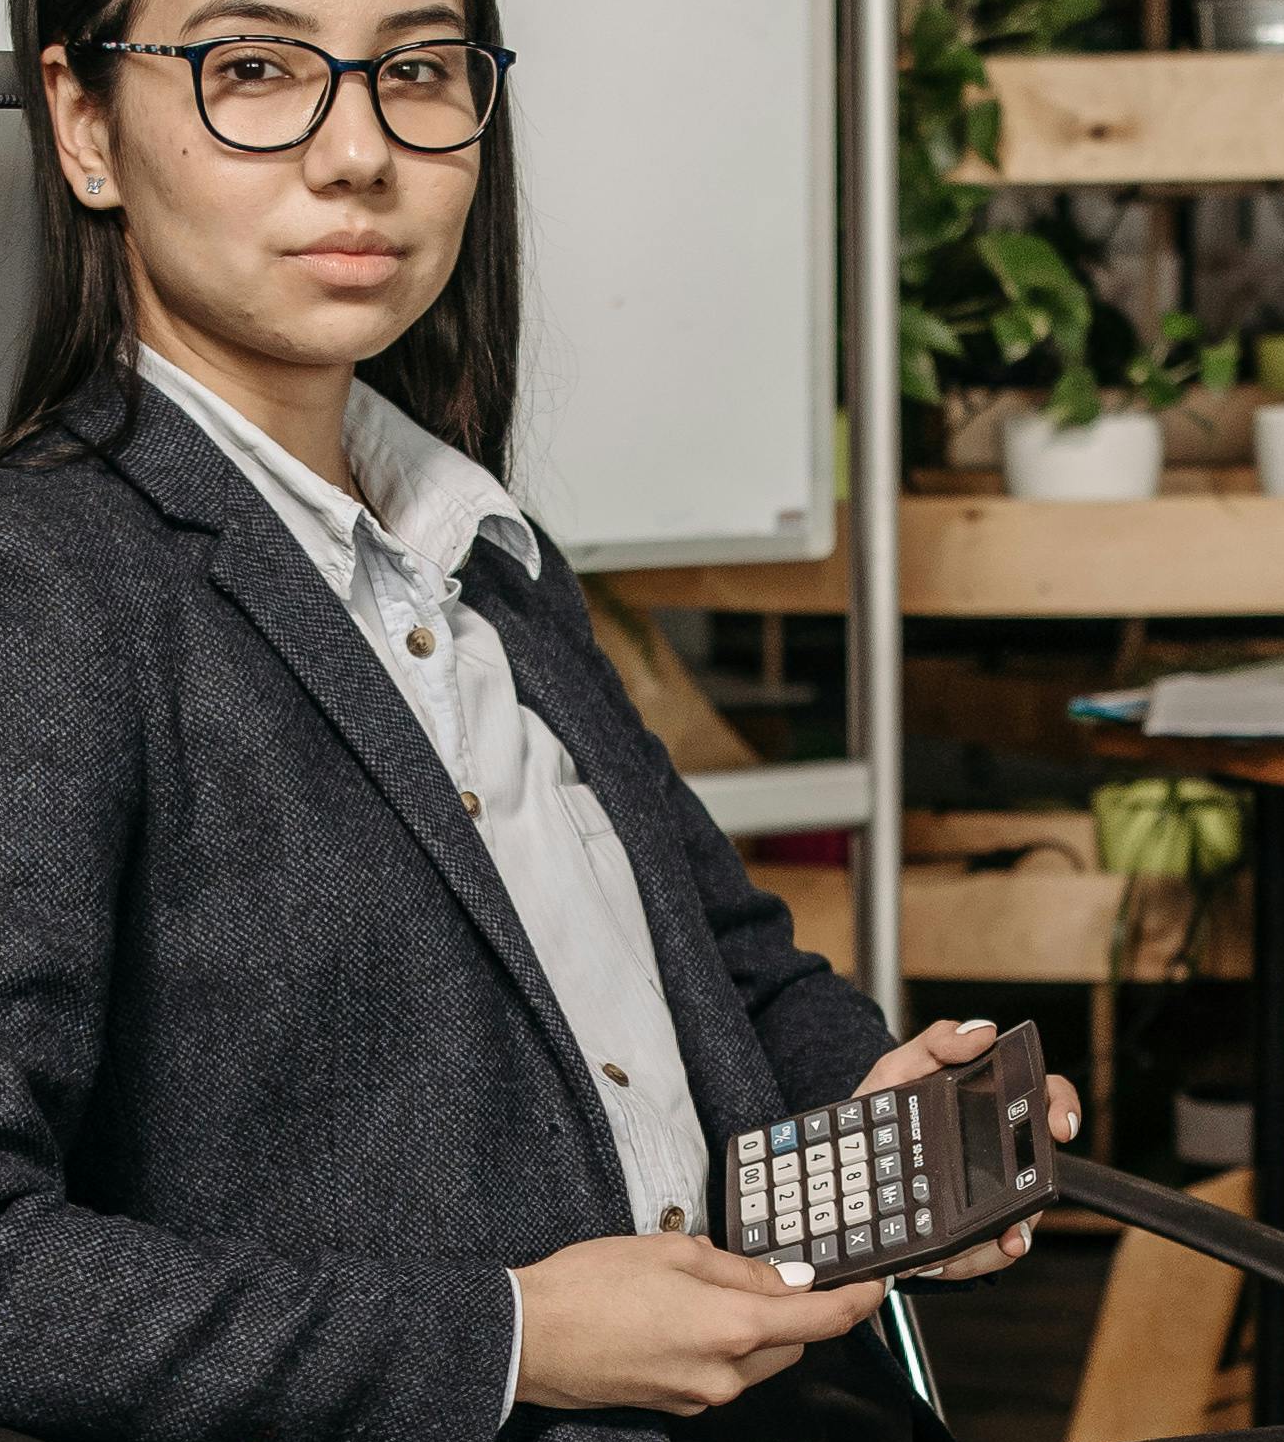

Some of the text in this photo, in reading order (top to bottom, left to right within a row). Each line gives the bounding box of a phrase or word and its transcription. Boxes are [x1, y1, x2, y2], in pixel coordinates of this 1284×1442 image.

[875, 1096, 890, 1114] MC
[908, 1094, 921, 1141] CORRECT
[743, 1141, 758, 1150] 0
[844, 1141, 860, 1149] 7
[811, 1153, 826, 1162] 4
[777, 1163, 793, 1171] 1
[744, 1168, 760, 1185] 00
[846, 1171, 862, 1181] 8
[812, 1181, 828, 1191] 5
[779, 1191, 795, 1201] 2
[848, 1201, 864, 1211] 9
[814, 1211, 830, 1221] 6
[780, 1220, 796, 1230] 3
